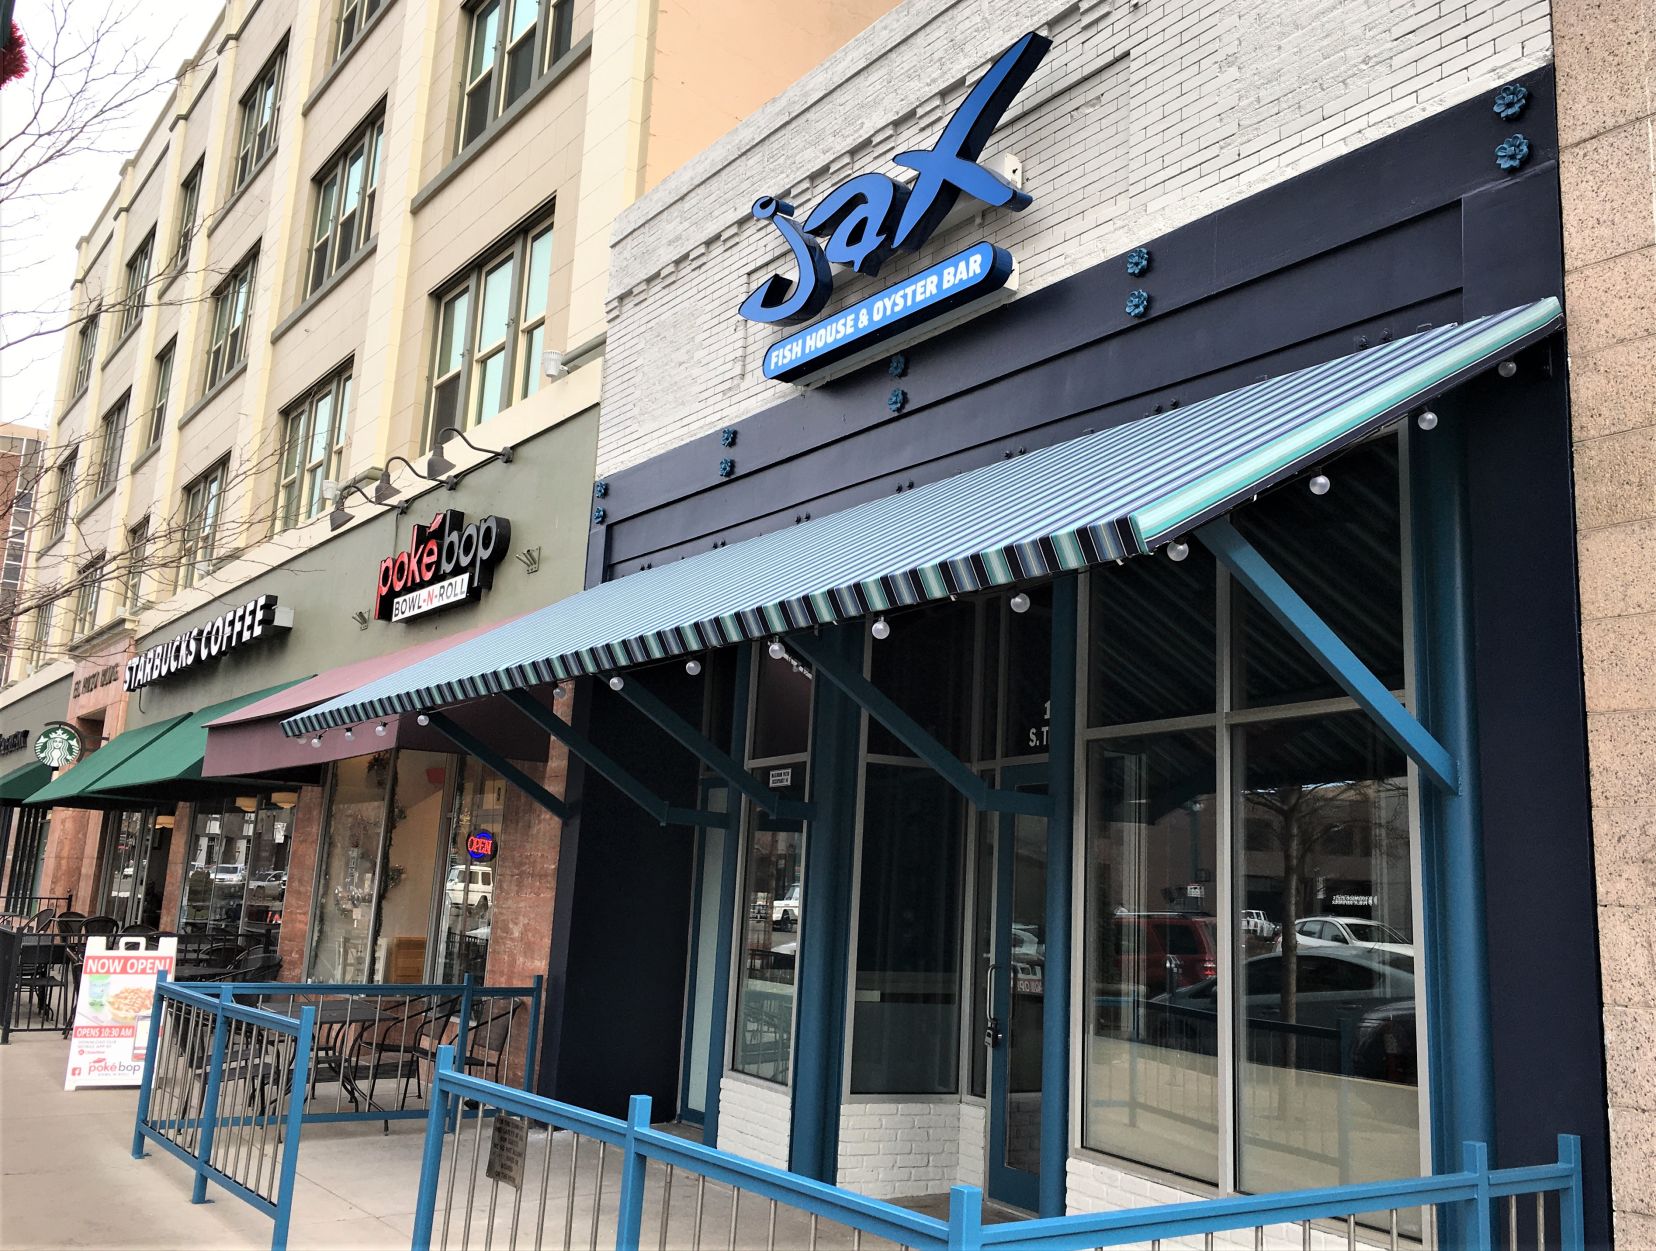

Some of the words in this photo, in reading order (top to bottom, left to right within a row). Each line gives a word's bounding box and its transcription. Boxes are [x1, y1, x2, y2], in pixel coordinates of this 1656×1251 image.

[770, 338, 803, 370] FISH
[804, 312, 855, 355] HOUSE
[857, 307, 869, 330] &
[872, 274, 938, 322] OYSTER
[942, 253, 983, 291] BAR
[393, 577, 467, 618] BOWL-N-ROLL
[123, 625, 200, 693] STARBUCKS
[200, 594, 268, 661] COFFEE
[1029, 727, 1040, 747] S.
[467, 836, 493, 855] OPEN
[86, 958, 125, 974] NOW
[126, 957, 171, 974] OPEN!
[76, 1027, 100, 1038] OPENS
[101, 1027, 119, 1038] 10:30
[120, 1027, 133, 1037] AM
